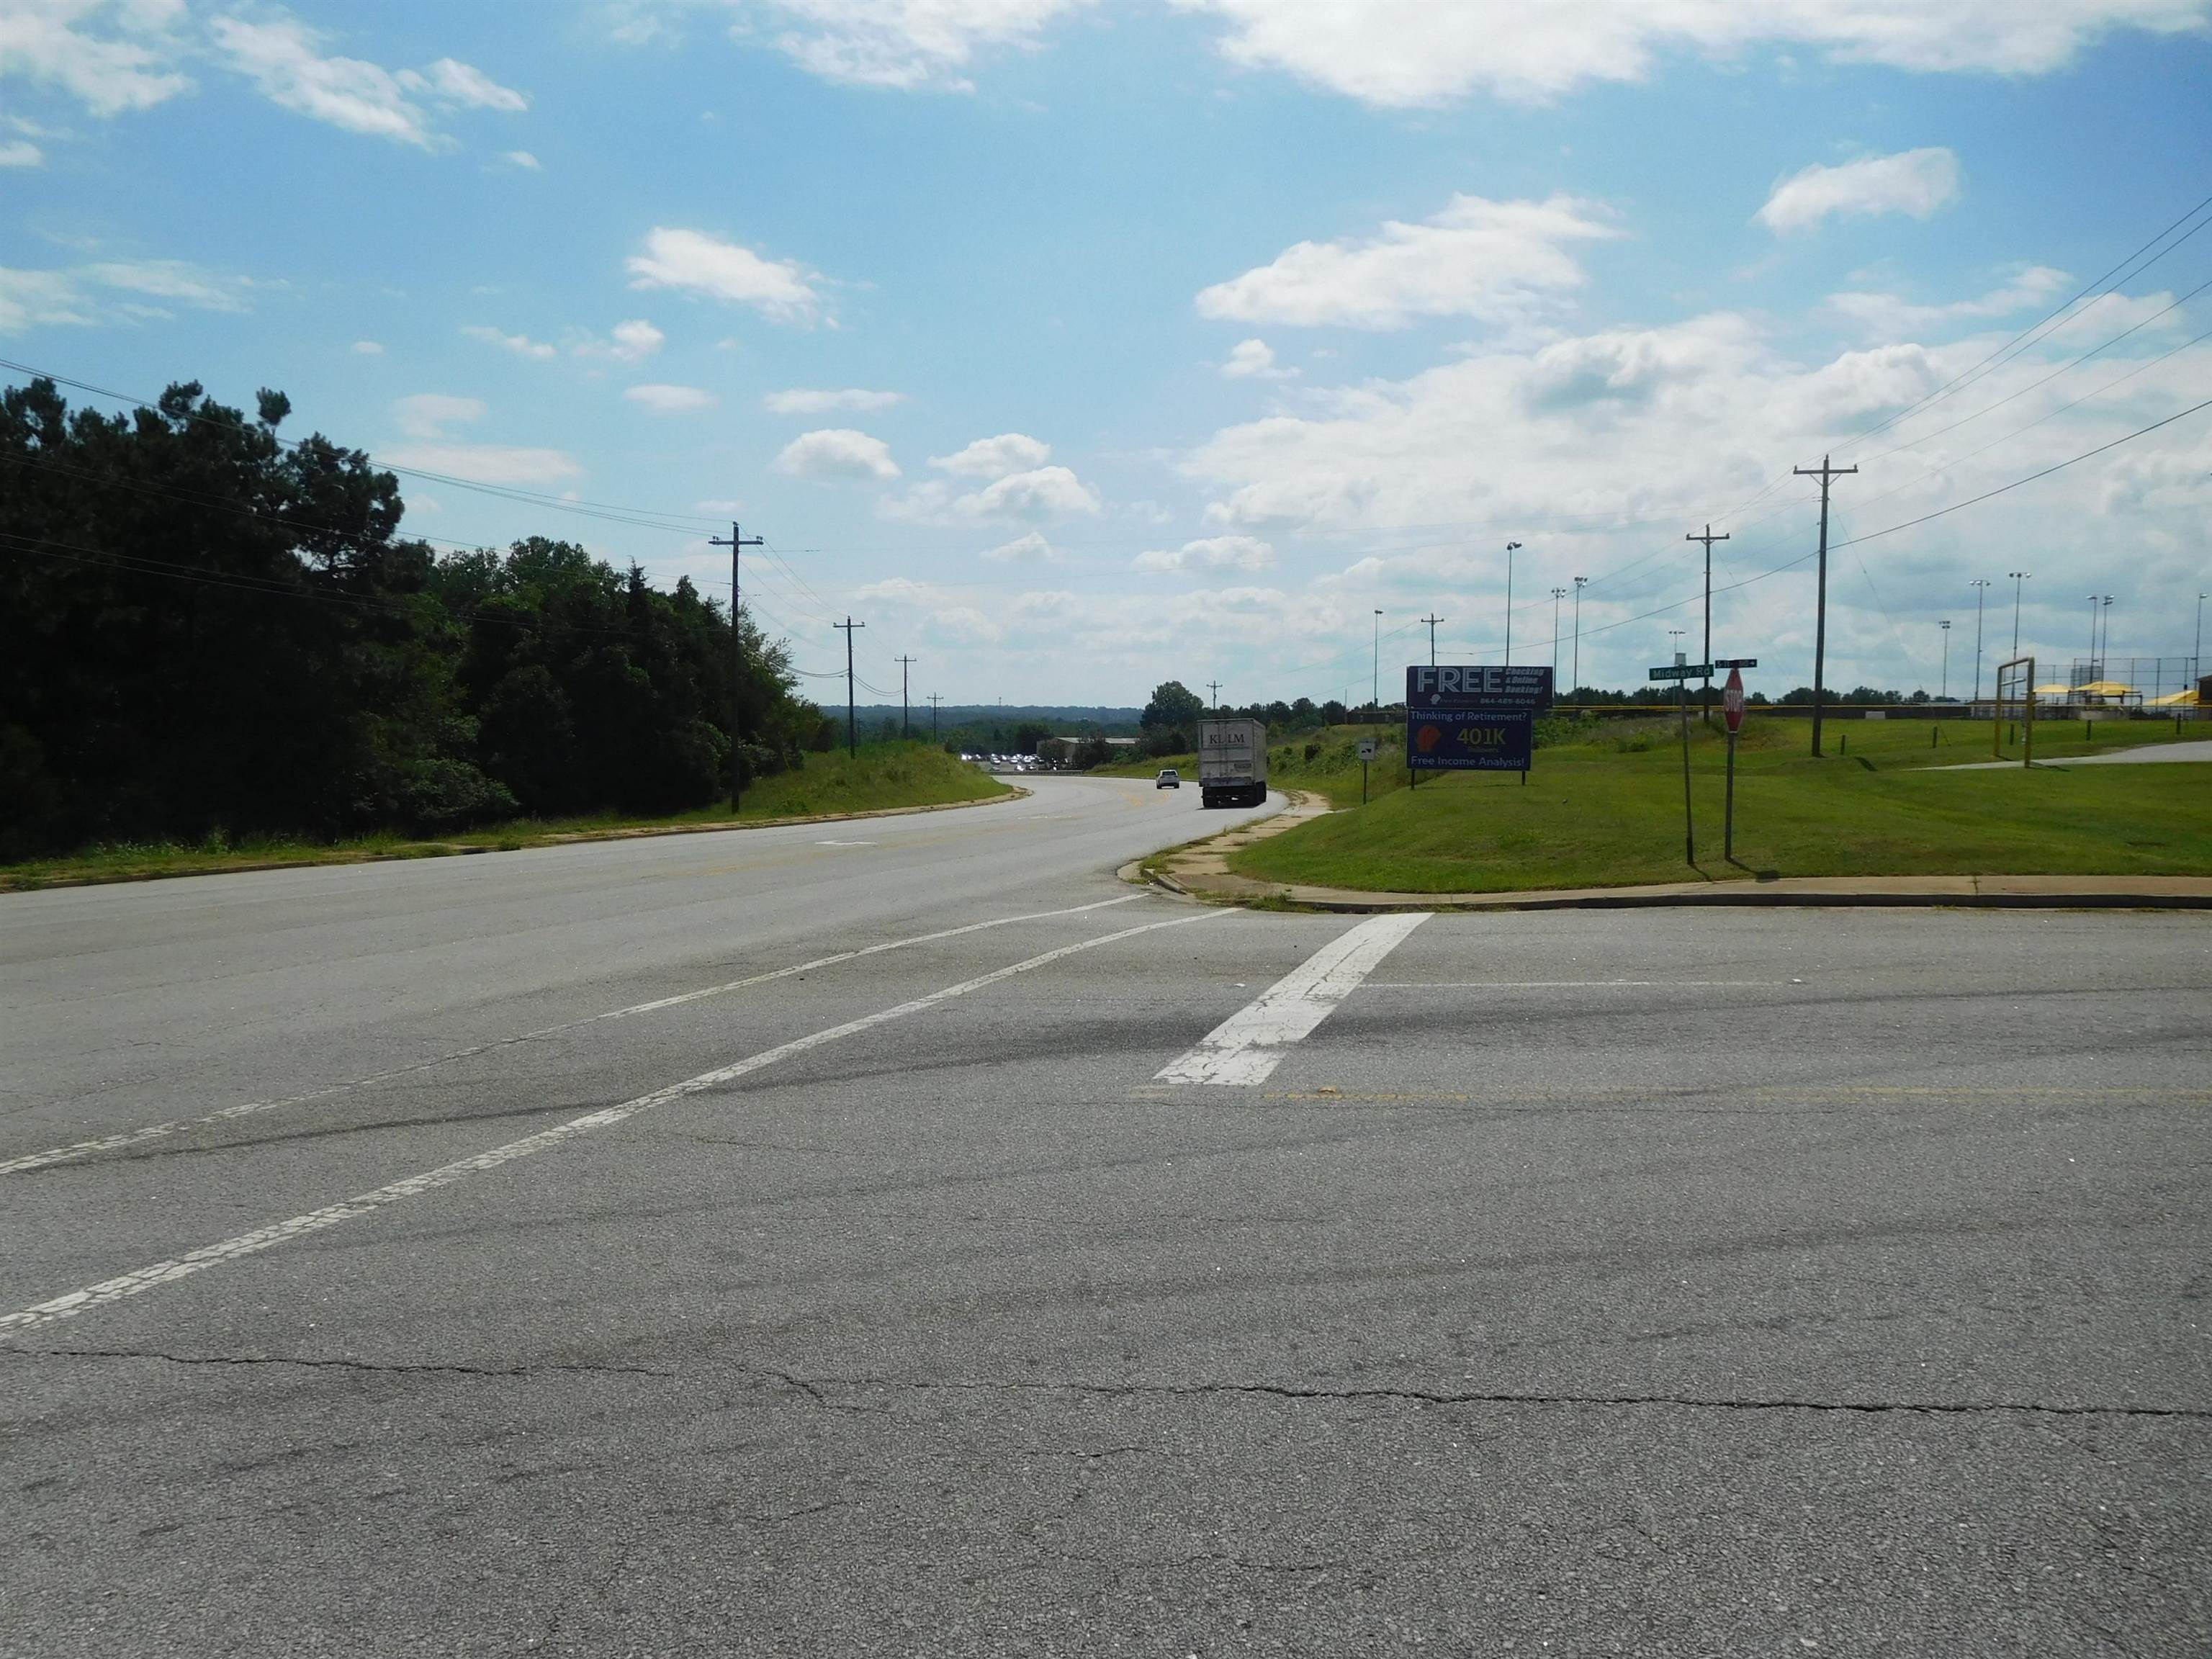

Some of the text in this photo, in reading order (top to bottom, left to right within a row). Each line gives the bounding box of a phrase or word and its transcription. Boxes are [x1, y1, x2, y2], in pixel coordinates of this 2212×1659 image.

[1653, 666, 1710, 678] Midway Rd
[1416, 667, 1503, 693] FREE
[1411, 711, 1527, 721] Thinking of Retirement?
[1457, 727, 1507, 745] 401K
[1411, 756, 1525, 768] Free Income Analysis!
